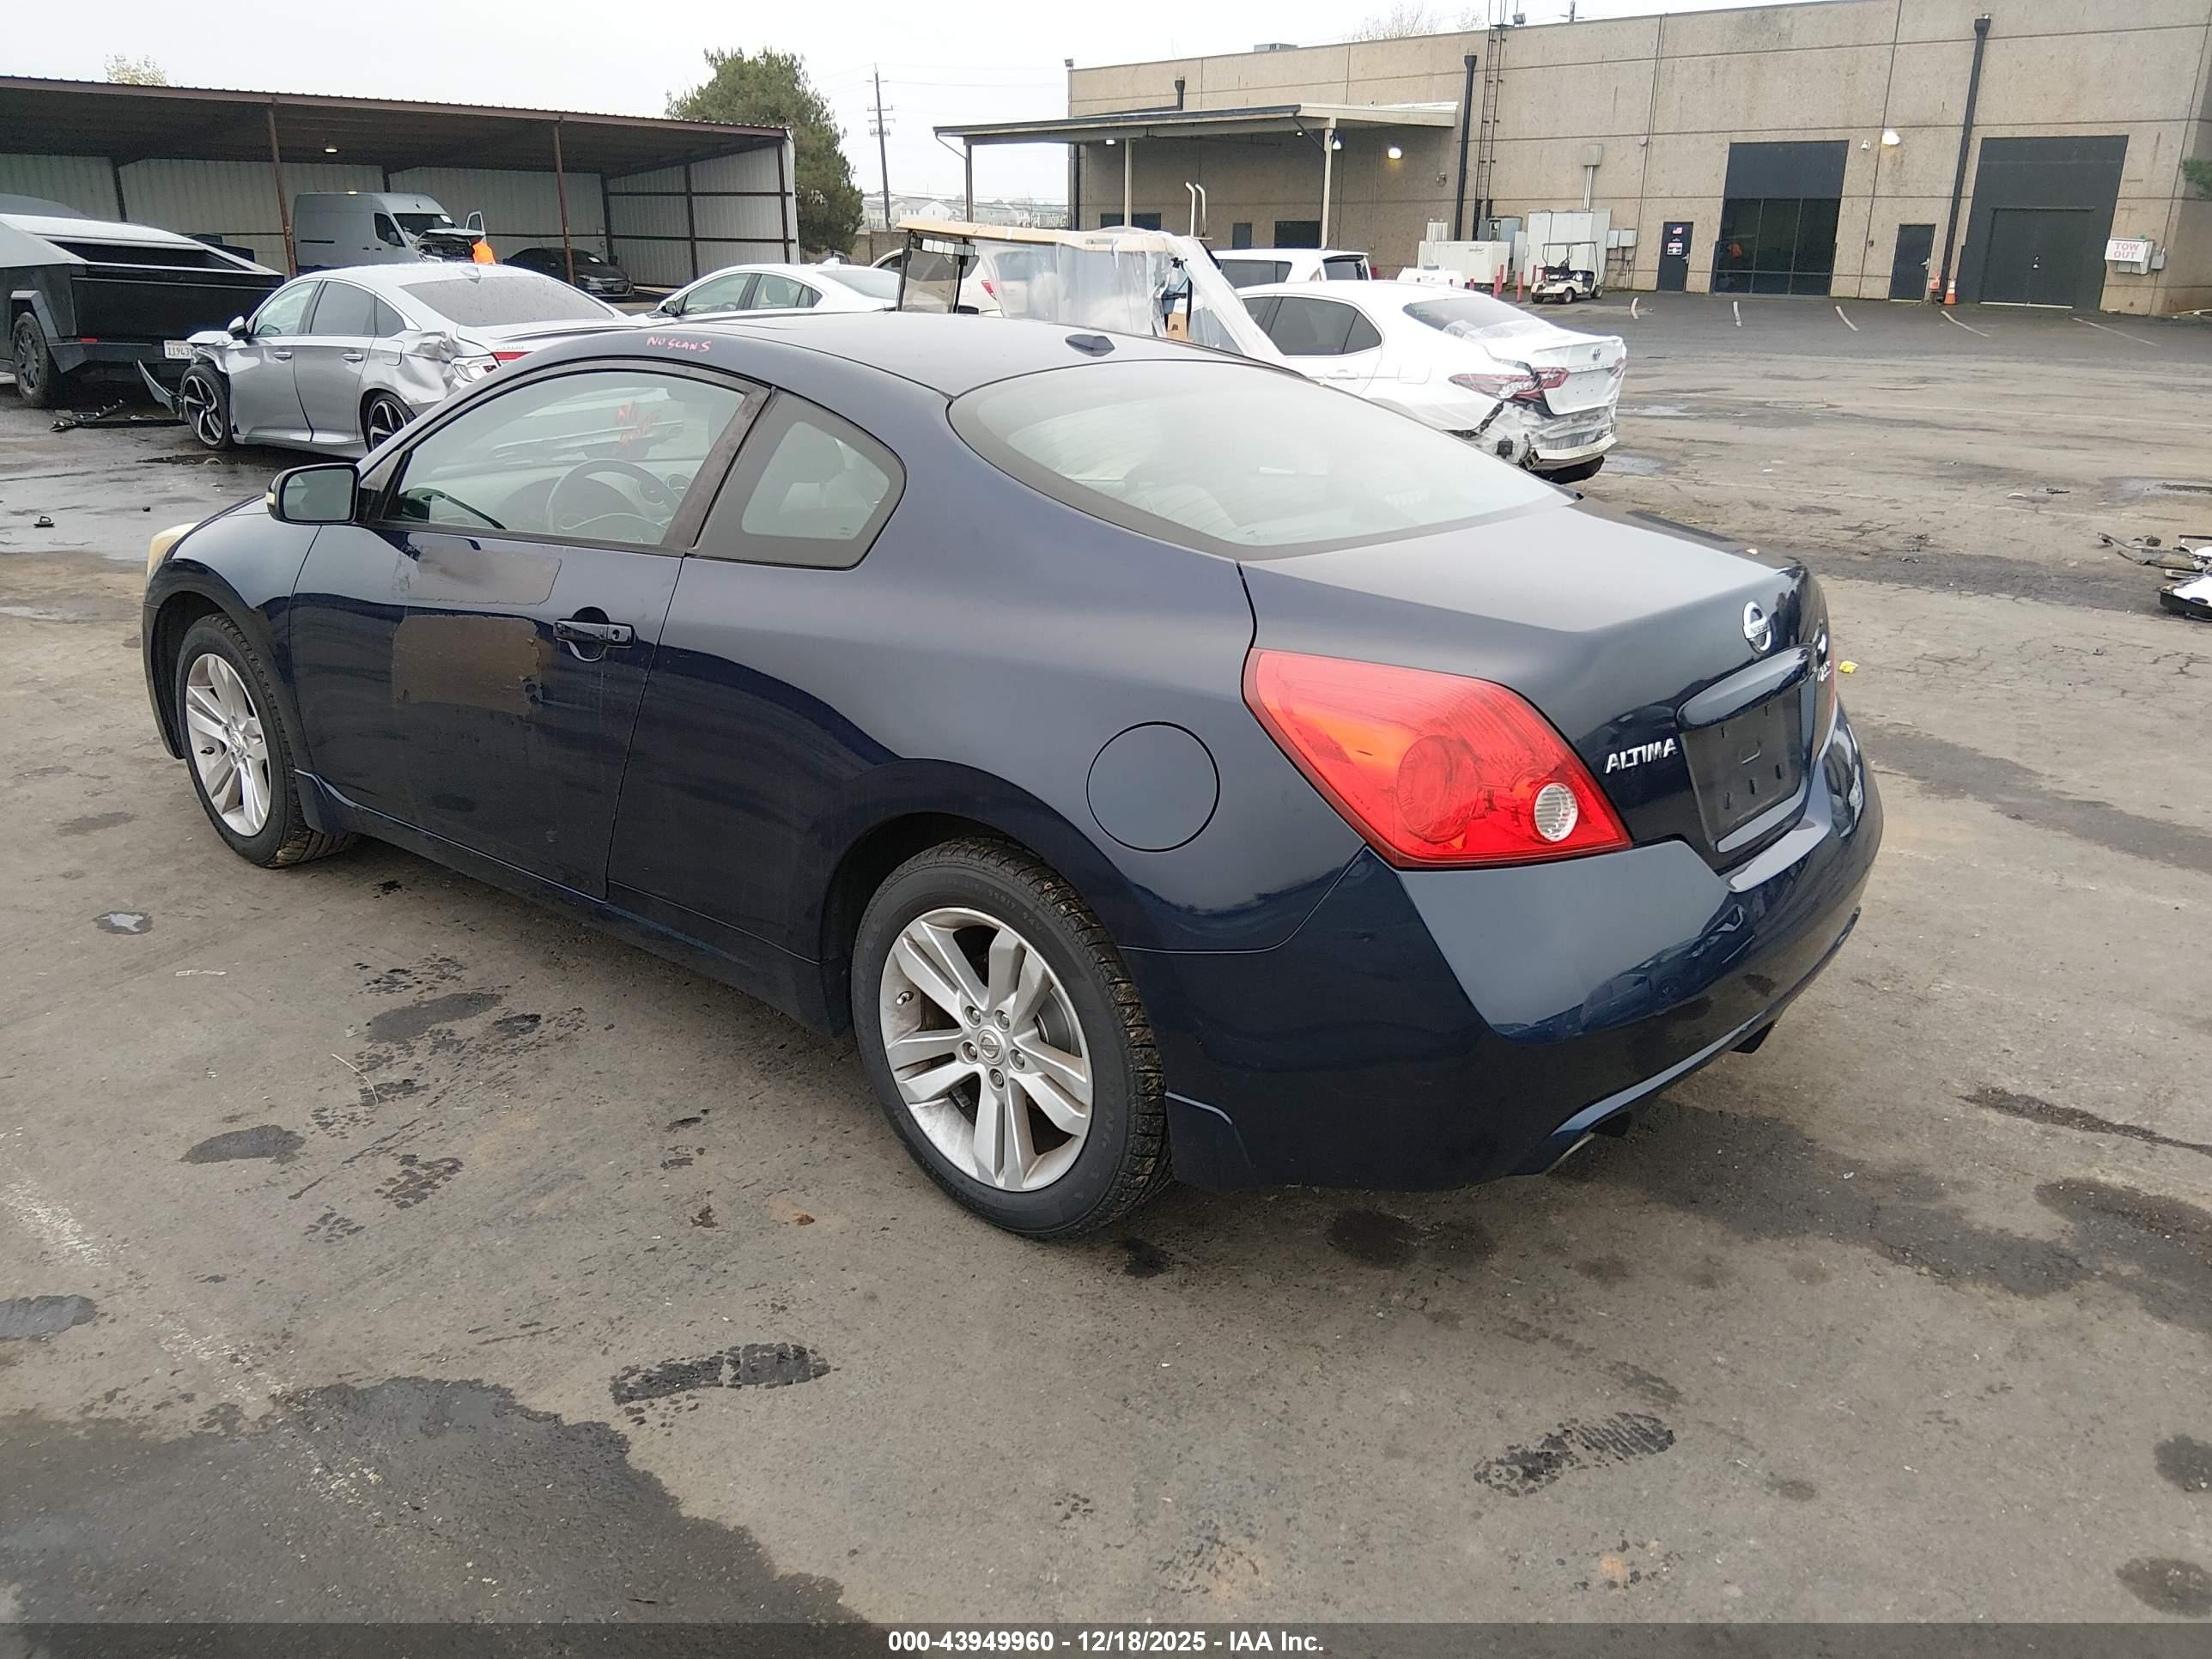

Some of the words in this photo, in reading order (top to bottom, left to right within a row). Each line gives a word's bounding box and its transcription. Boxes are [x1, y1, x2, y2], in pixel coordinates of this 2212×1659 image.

[2115, 242, 2140, 251] TOW
[647, 336, 666, 346] NO
[1604, 738, 1677, 774] ALTIMA
